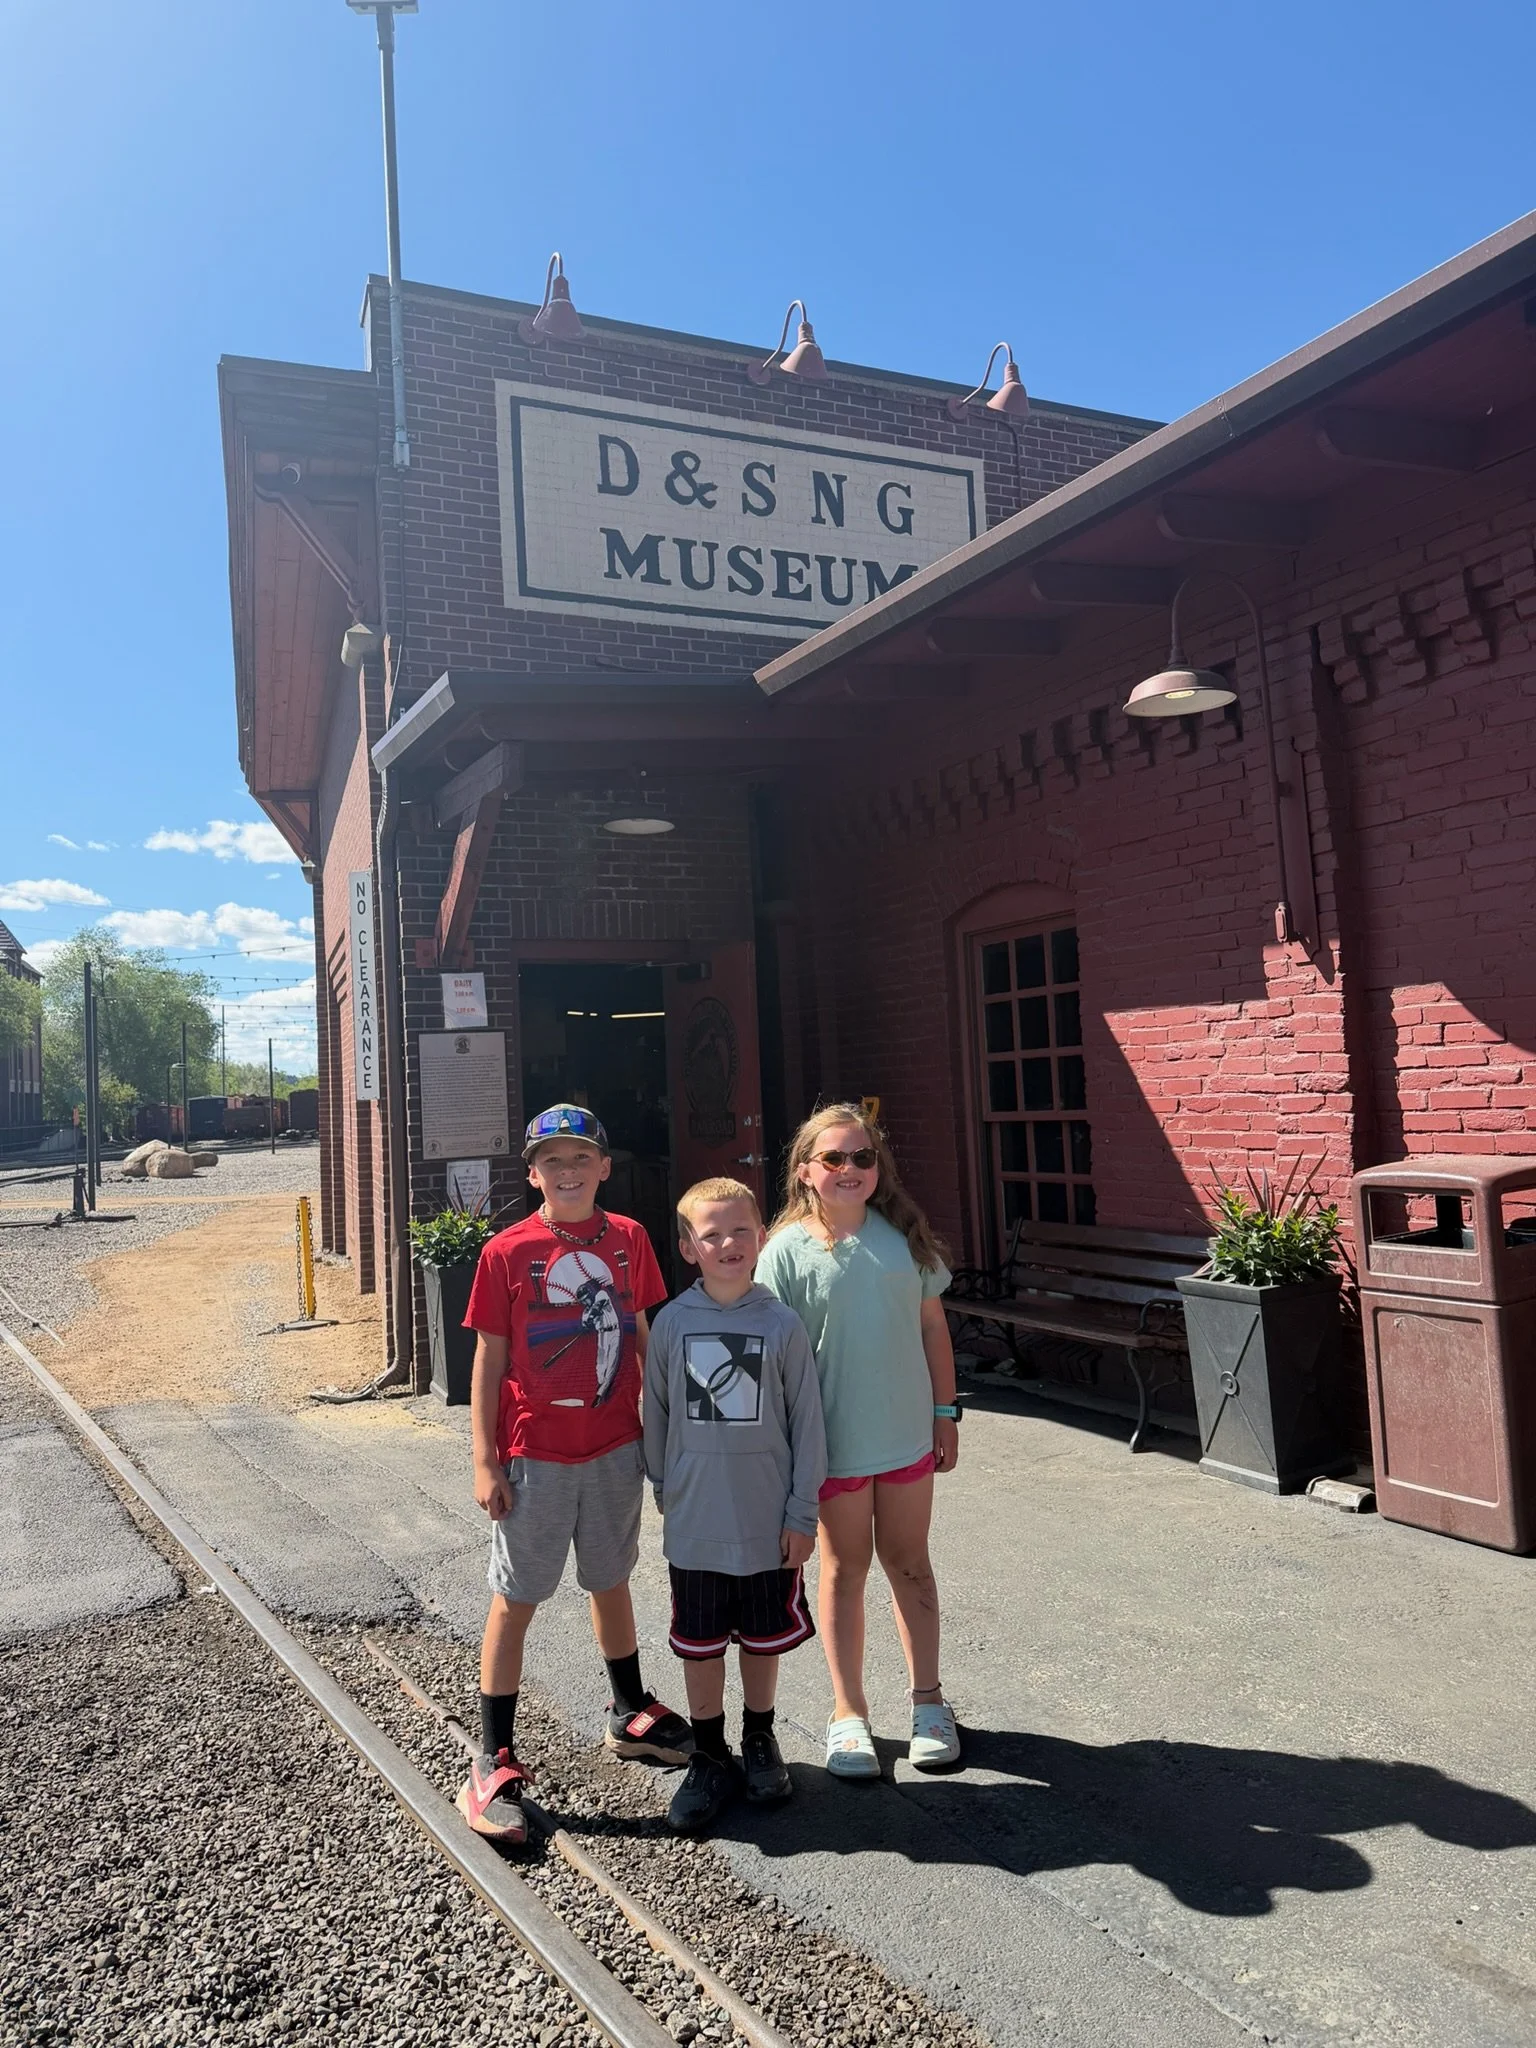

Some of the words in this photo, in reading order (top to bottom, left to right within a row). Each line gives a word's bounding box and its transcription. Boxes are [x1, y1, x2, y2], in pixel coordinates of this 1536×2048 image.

[599, 527, 919, 607] MUSEUM
[356, 881, 366, 915] NO
[358, 929, 372, 1089] CLEARANCE
